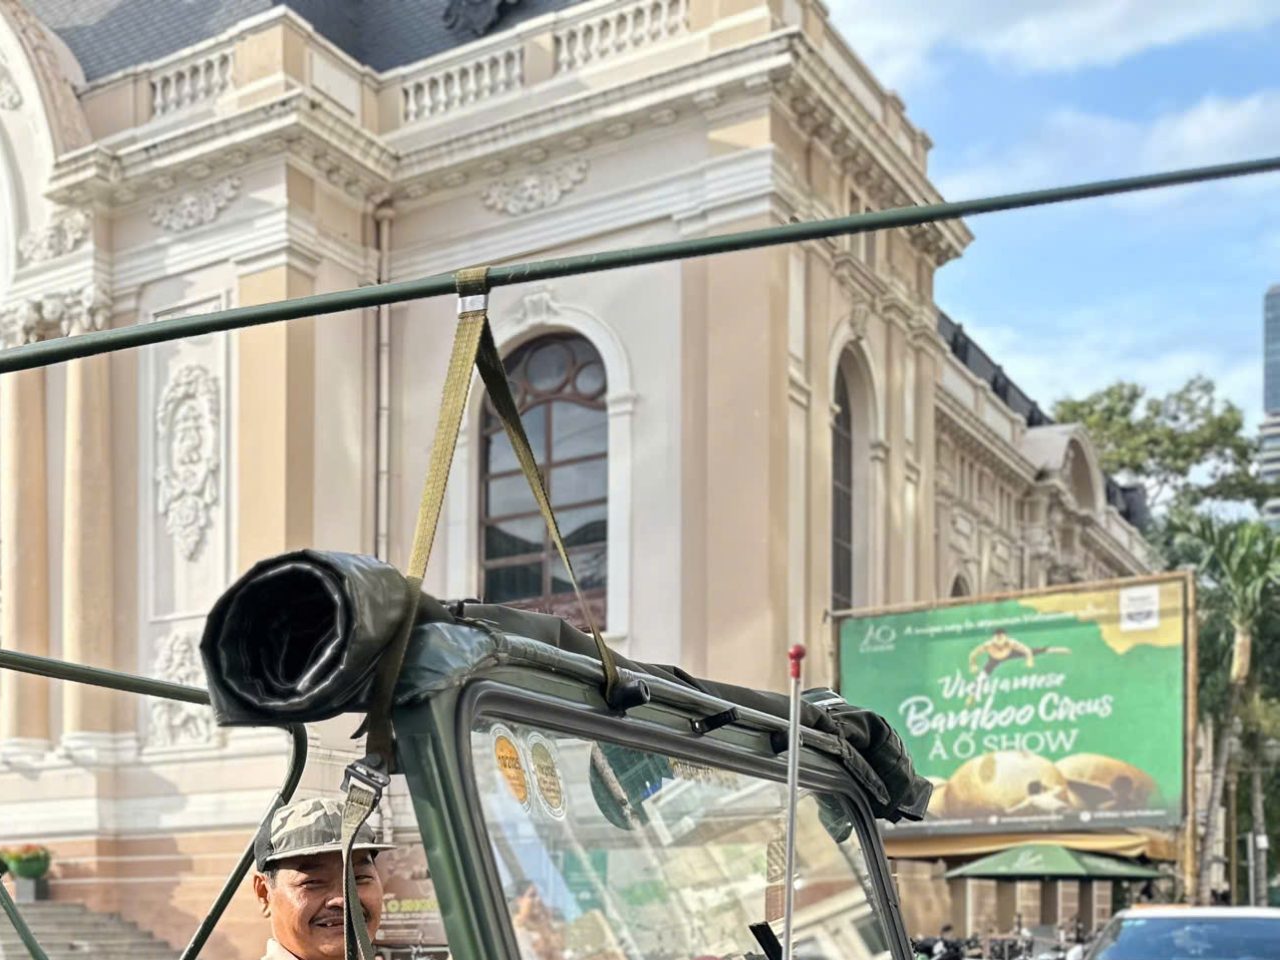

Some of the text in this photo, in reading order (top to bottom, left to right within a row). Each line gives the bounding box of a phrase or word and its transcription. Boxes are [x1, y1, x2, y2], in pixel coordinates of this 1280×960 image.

[937, 668, 1066, 702] Vietnamese
[898, 692, 1114, 736] Bamboo Circus
[981, 728, 1080, 754] SHOW
